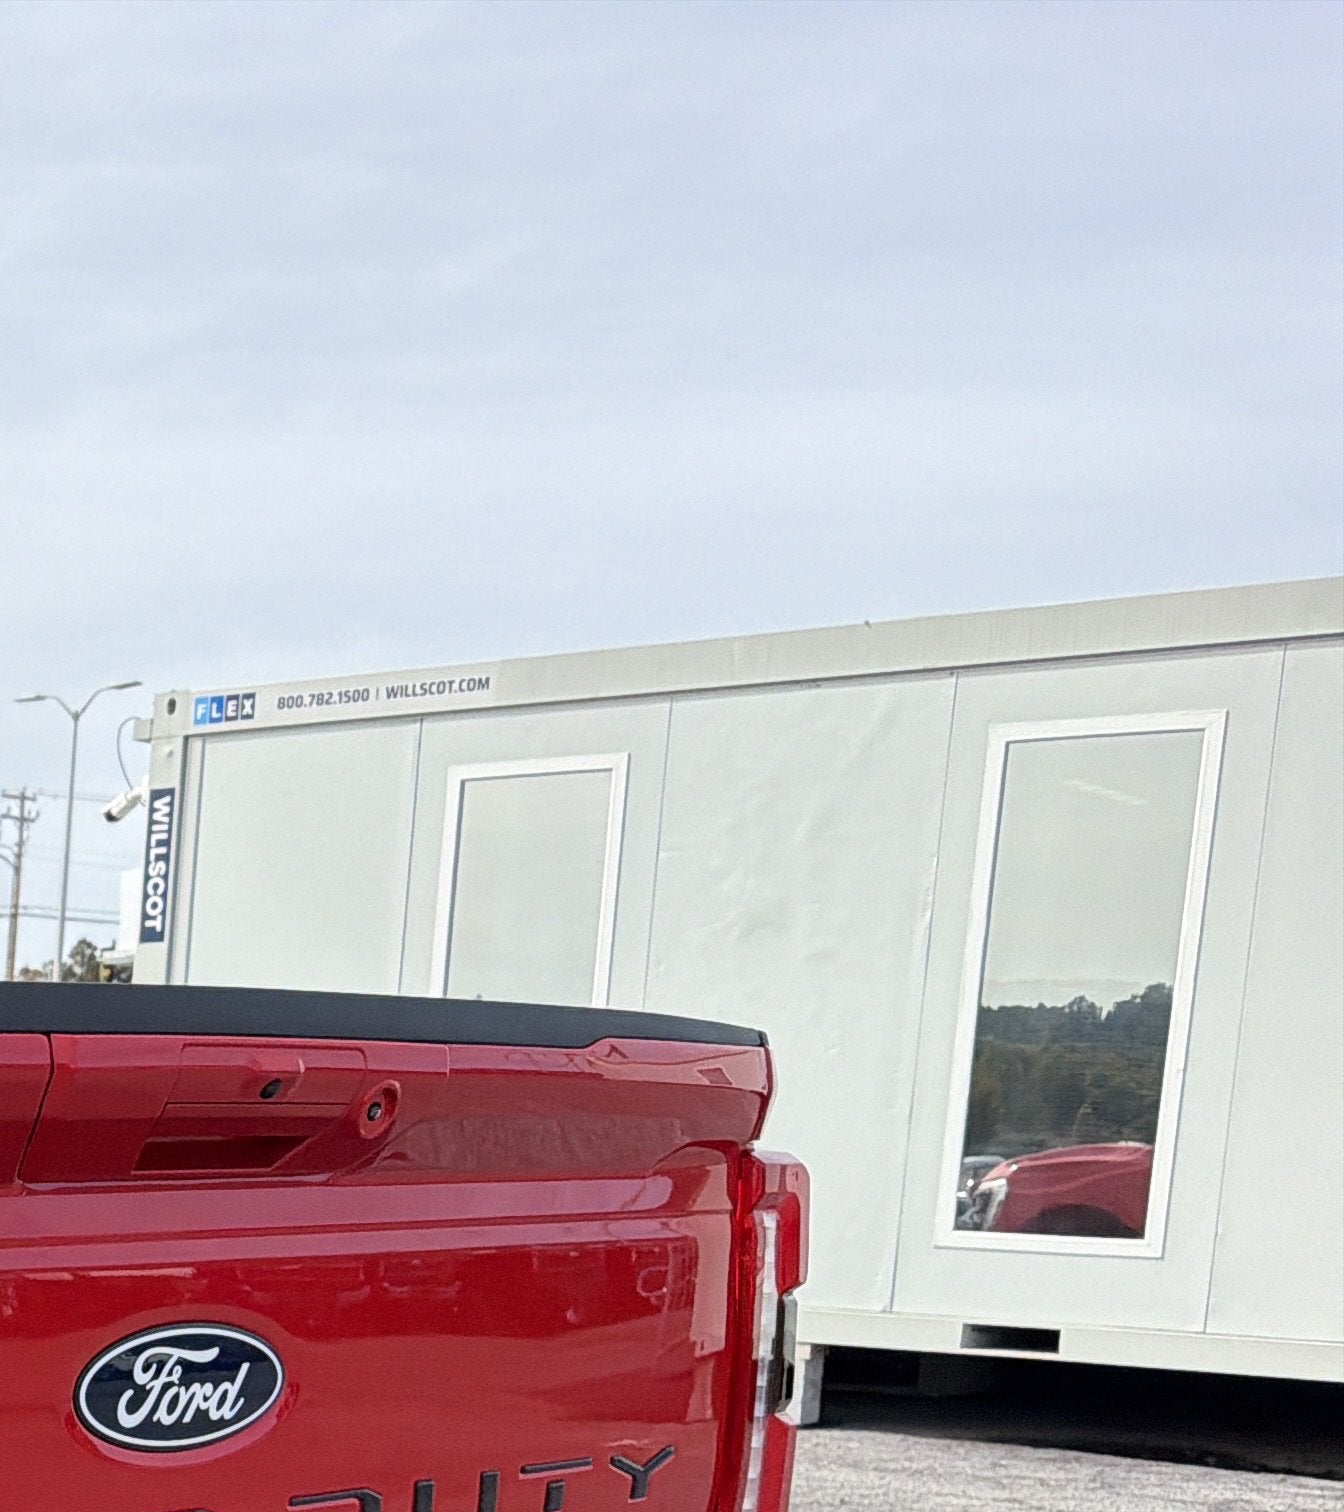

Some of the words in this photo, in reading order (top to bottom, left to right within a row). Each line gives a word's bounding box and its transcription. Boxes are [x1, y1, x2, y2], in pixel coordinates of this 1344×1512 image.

[195, 694, 255, 720] FLEX
[277, 687, 370, 710] 800.782.1500
[385, 676, 491, 701] WILLSCOT.COM
[144, 795, 171, 933] WILLSCOT
[116, 1346, 250, 1429] Ford
